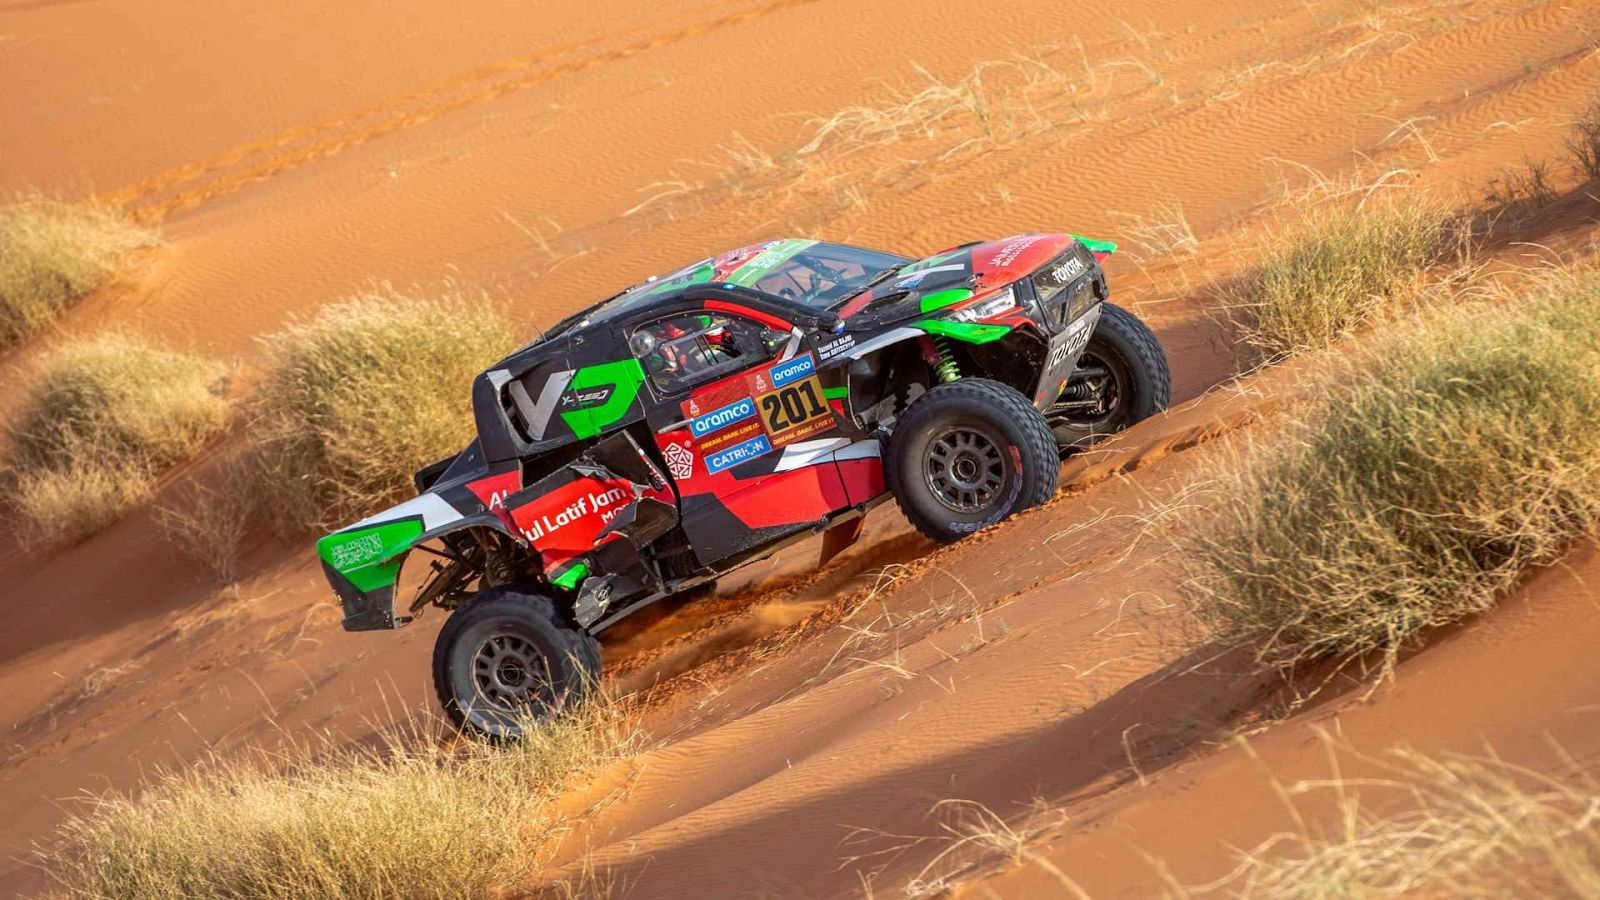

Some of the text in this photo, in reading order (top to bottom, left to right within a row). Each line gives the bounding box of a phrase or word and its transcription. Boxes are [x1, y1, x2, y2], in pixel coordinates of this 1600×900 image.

[1052, 257, 1084, 284] TOYOTA
[1048, 323, 1092, 370] TOYOTA
[774, 361, 811, 381] aramco
[695, 403, 750, 432] aramco
[763, 381, 827, 433] 201
[712, 440, 764, 468] CATRION
[543, 497, 588, 532] Latif
